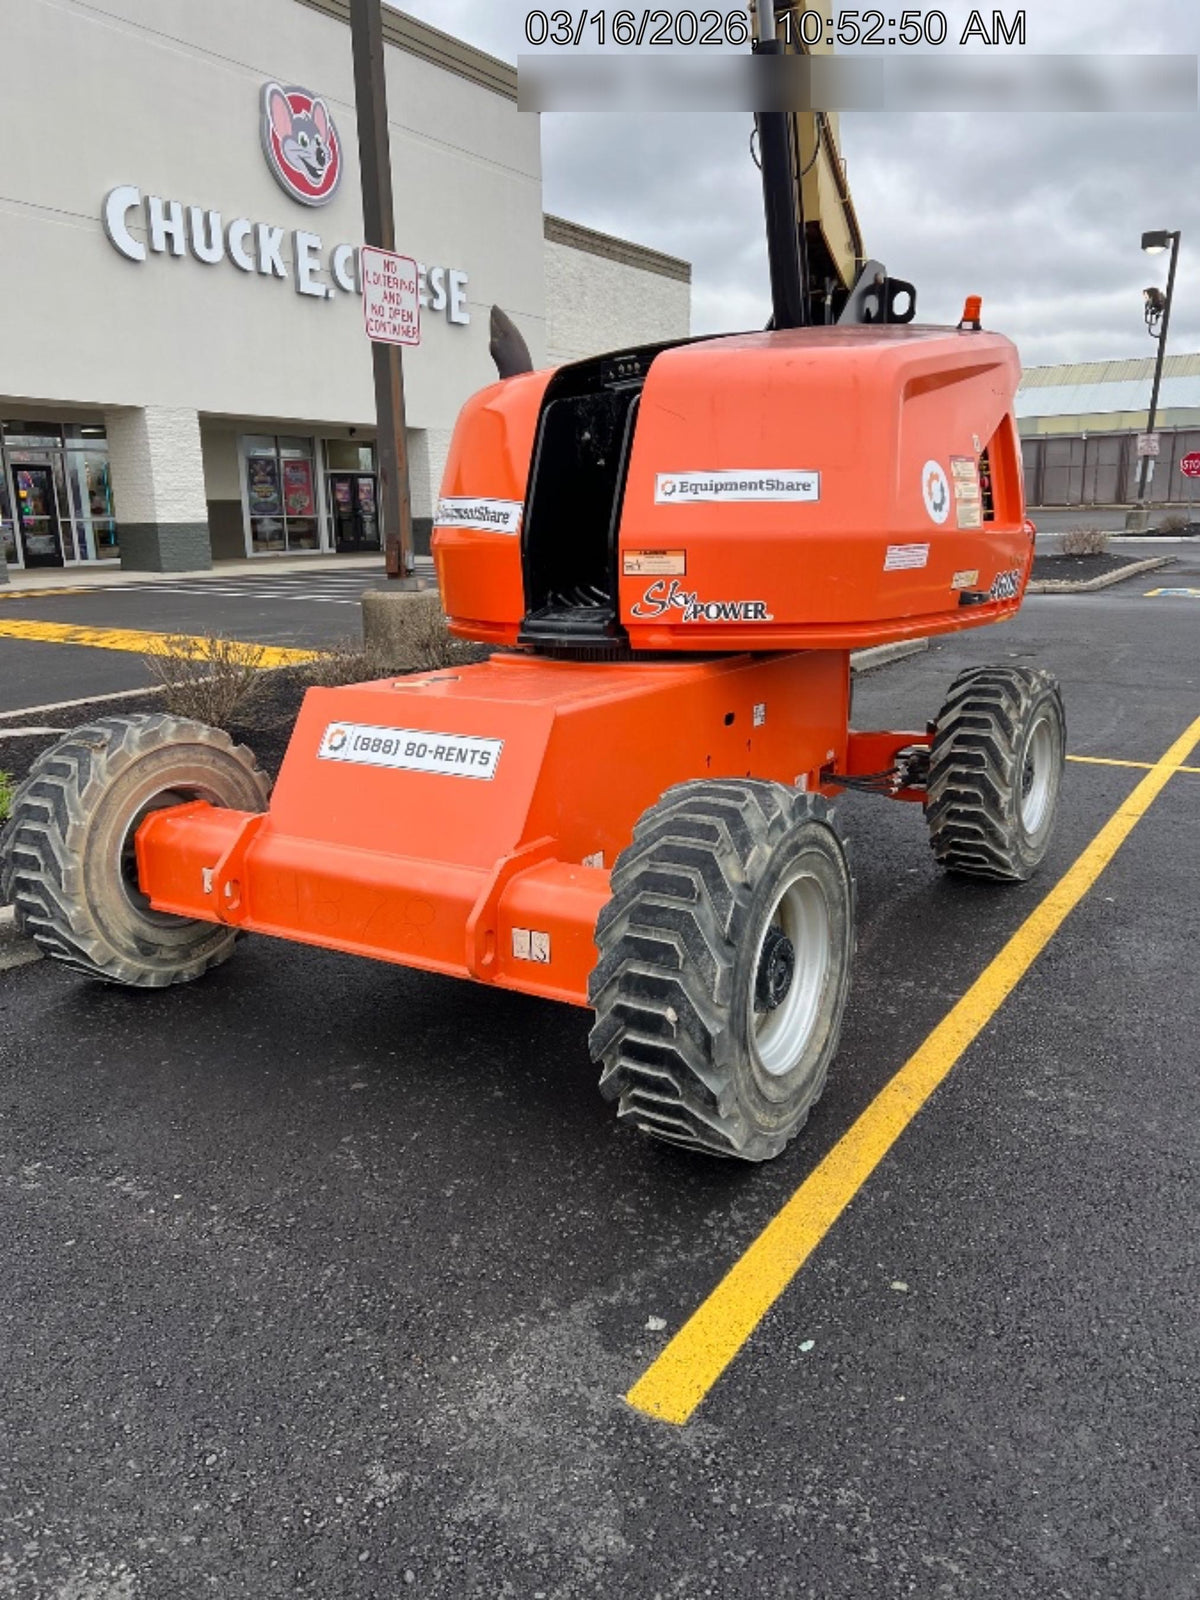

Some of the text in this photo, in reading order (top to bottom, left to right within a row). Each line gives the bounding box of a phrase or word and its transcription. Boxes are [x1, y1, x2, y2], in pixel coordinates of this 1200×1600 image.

[103, 184, 288, 278] CHUCK
[331, 244, 471, 326] CSE
[383, 259, 397, 273] NO
[365, 269, 415, 294] LOITERING
[382, 291, 402, 306] AND
[371, 304, 414, 323] NO OPEN
[1183, 460, 1200, 470] STO
[679, 479, 812, 496] EquipmentShare
[352, 735, 492, 766] (888) 80-RENTS
